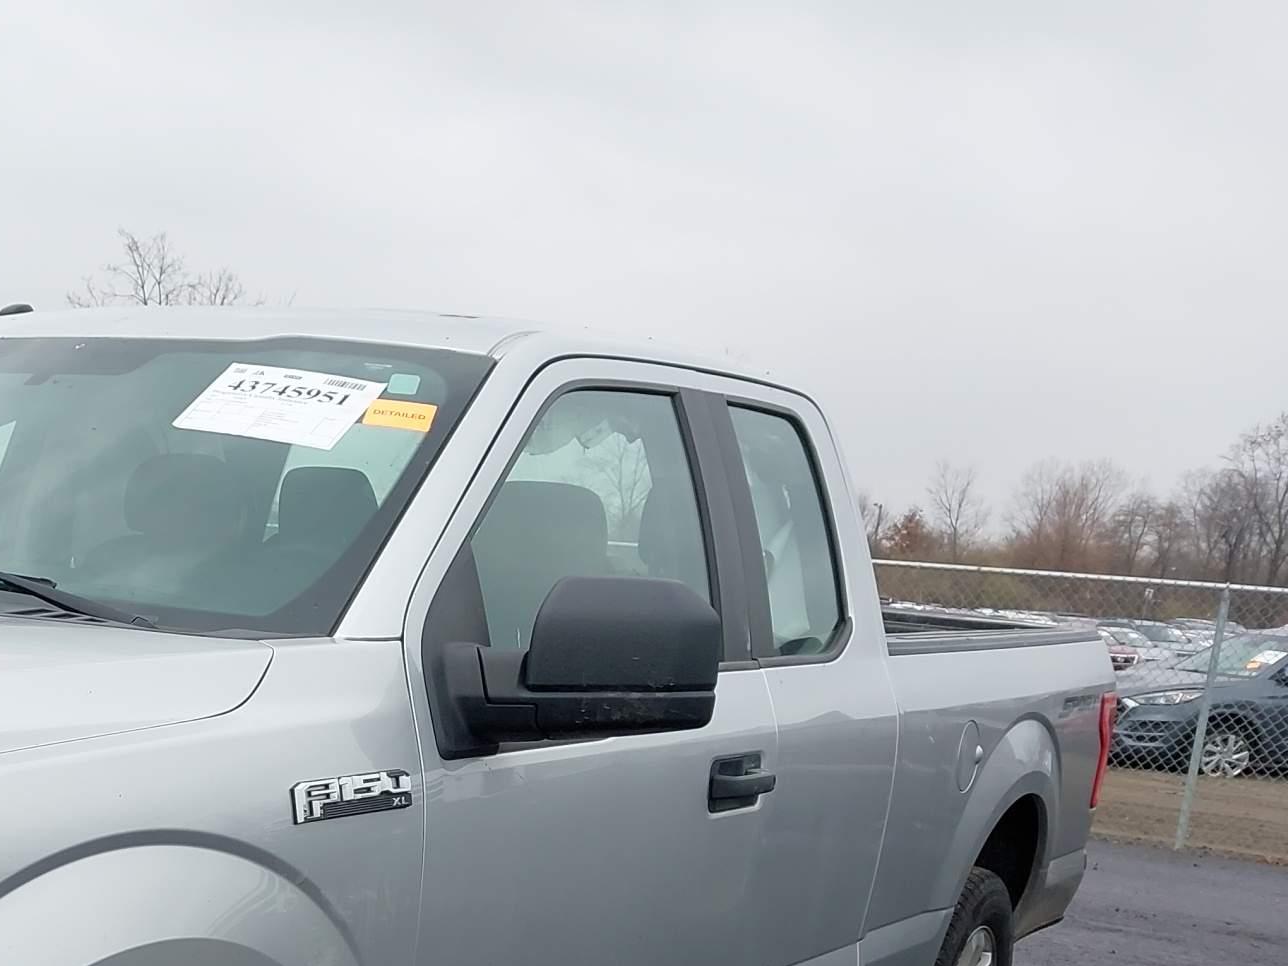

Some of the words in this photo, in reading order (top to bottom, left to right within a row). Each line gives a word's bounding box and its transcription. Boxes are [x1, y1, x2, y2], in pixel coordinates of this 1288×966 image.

[228, 378, 351, 406] 43745951
[372, 408, 426, 421] DETAILED
[392, 796, 409, 807] XL
